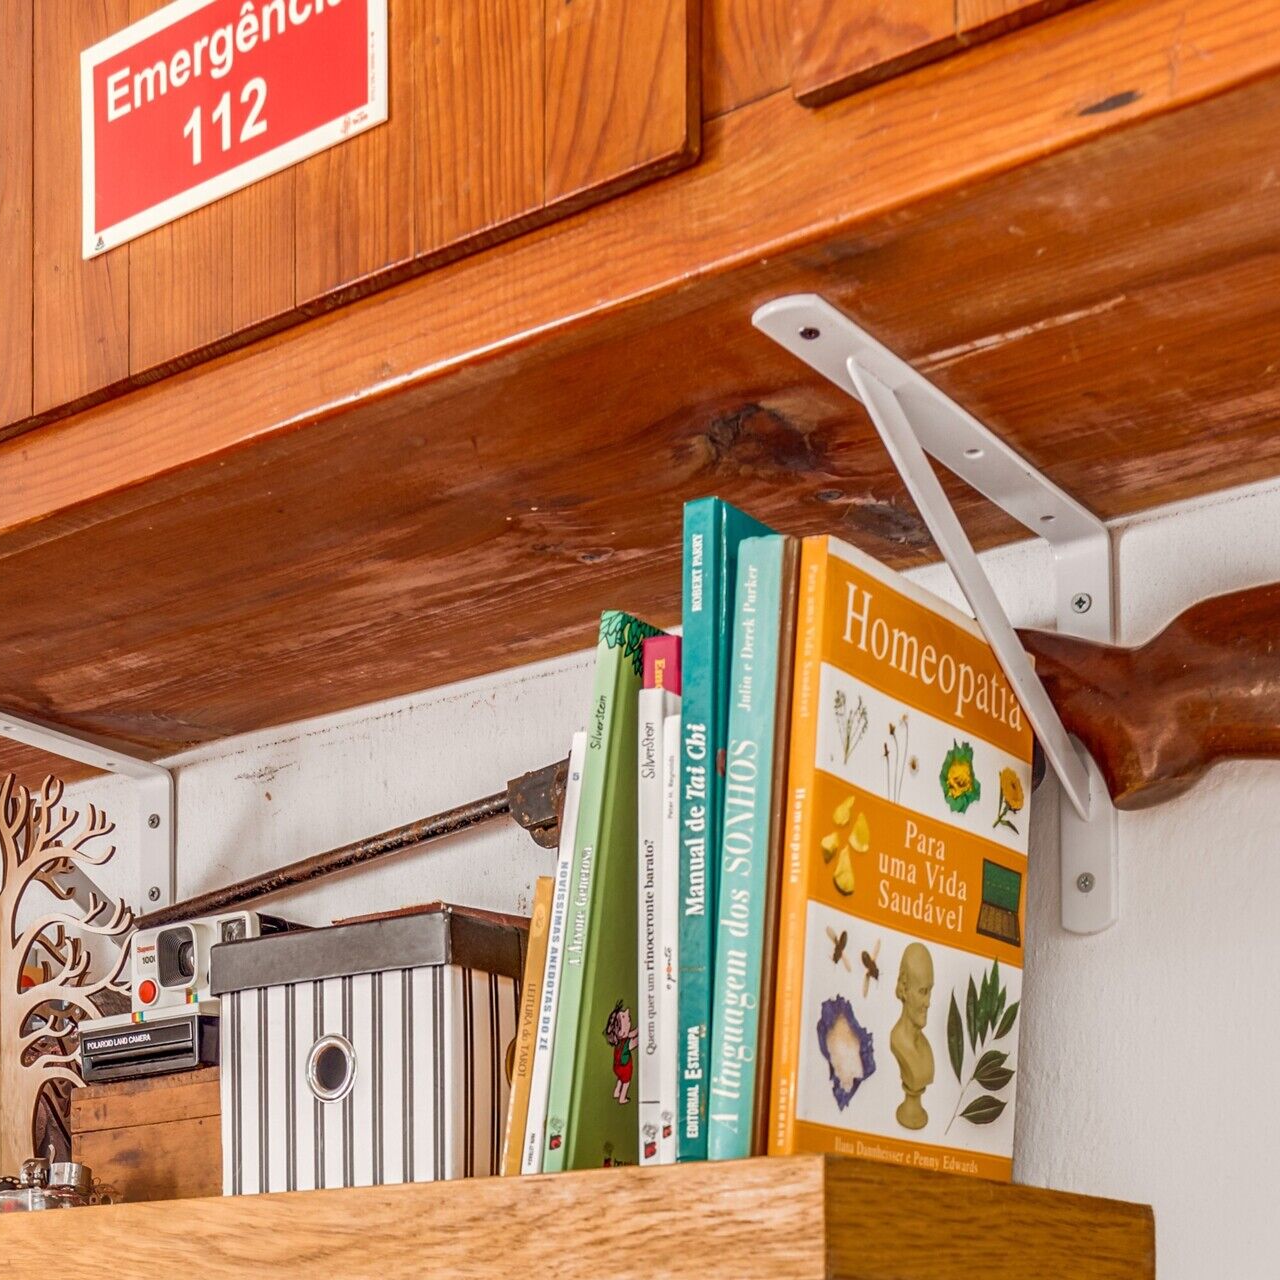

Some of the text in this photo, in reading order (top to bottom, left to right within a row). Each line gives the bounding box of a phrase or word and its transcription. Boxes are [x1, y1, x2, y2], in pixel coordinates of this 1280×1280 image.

[183, 77, 268, 166] 112
[692, 534, 703, 612] ROBERT PARRY
[743, 565, 758, 613] Parker
[741, 621, 756, 660] Derek
[842, 580, 1023, 732] Homeopatia
[738, 676, 753, 711] Julia
[685, 723, 707, 916] Manual de Tai Chi
[790, 788, 807, 884] Homeopatia
[904, 819, 946, 862] Para
[644, 839, 655, 887] barato?
[878, 851, 968, 902] uma Vida
[646, 890, 655, 971] rinoceronte
[878, 878, 965, 933] Saudável
[712, 738, 758, 1134] A linguagem dos SONHOS
[541, 945, 560, 1035] ANEDOTAS DO
[86, 1034, 152, 1051] POLAROID LAND CAMERA
[519, 983, 537, 1077] LEITURA TAROT
[646, 1027, 658, 1055] Quem
[686, 1084, 700, 1139] EDITORIAL
[942, 1152, 980, 1176] Edwards
